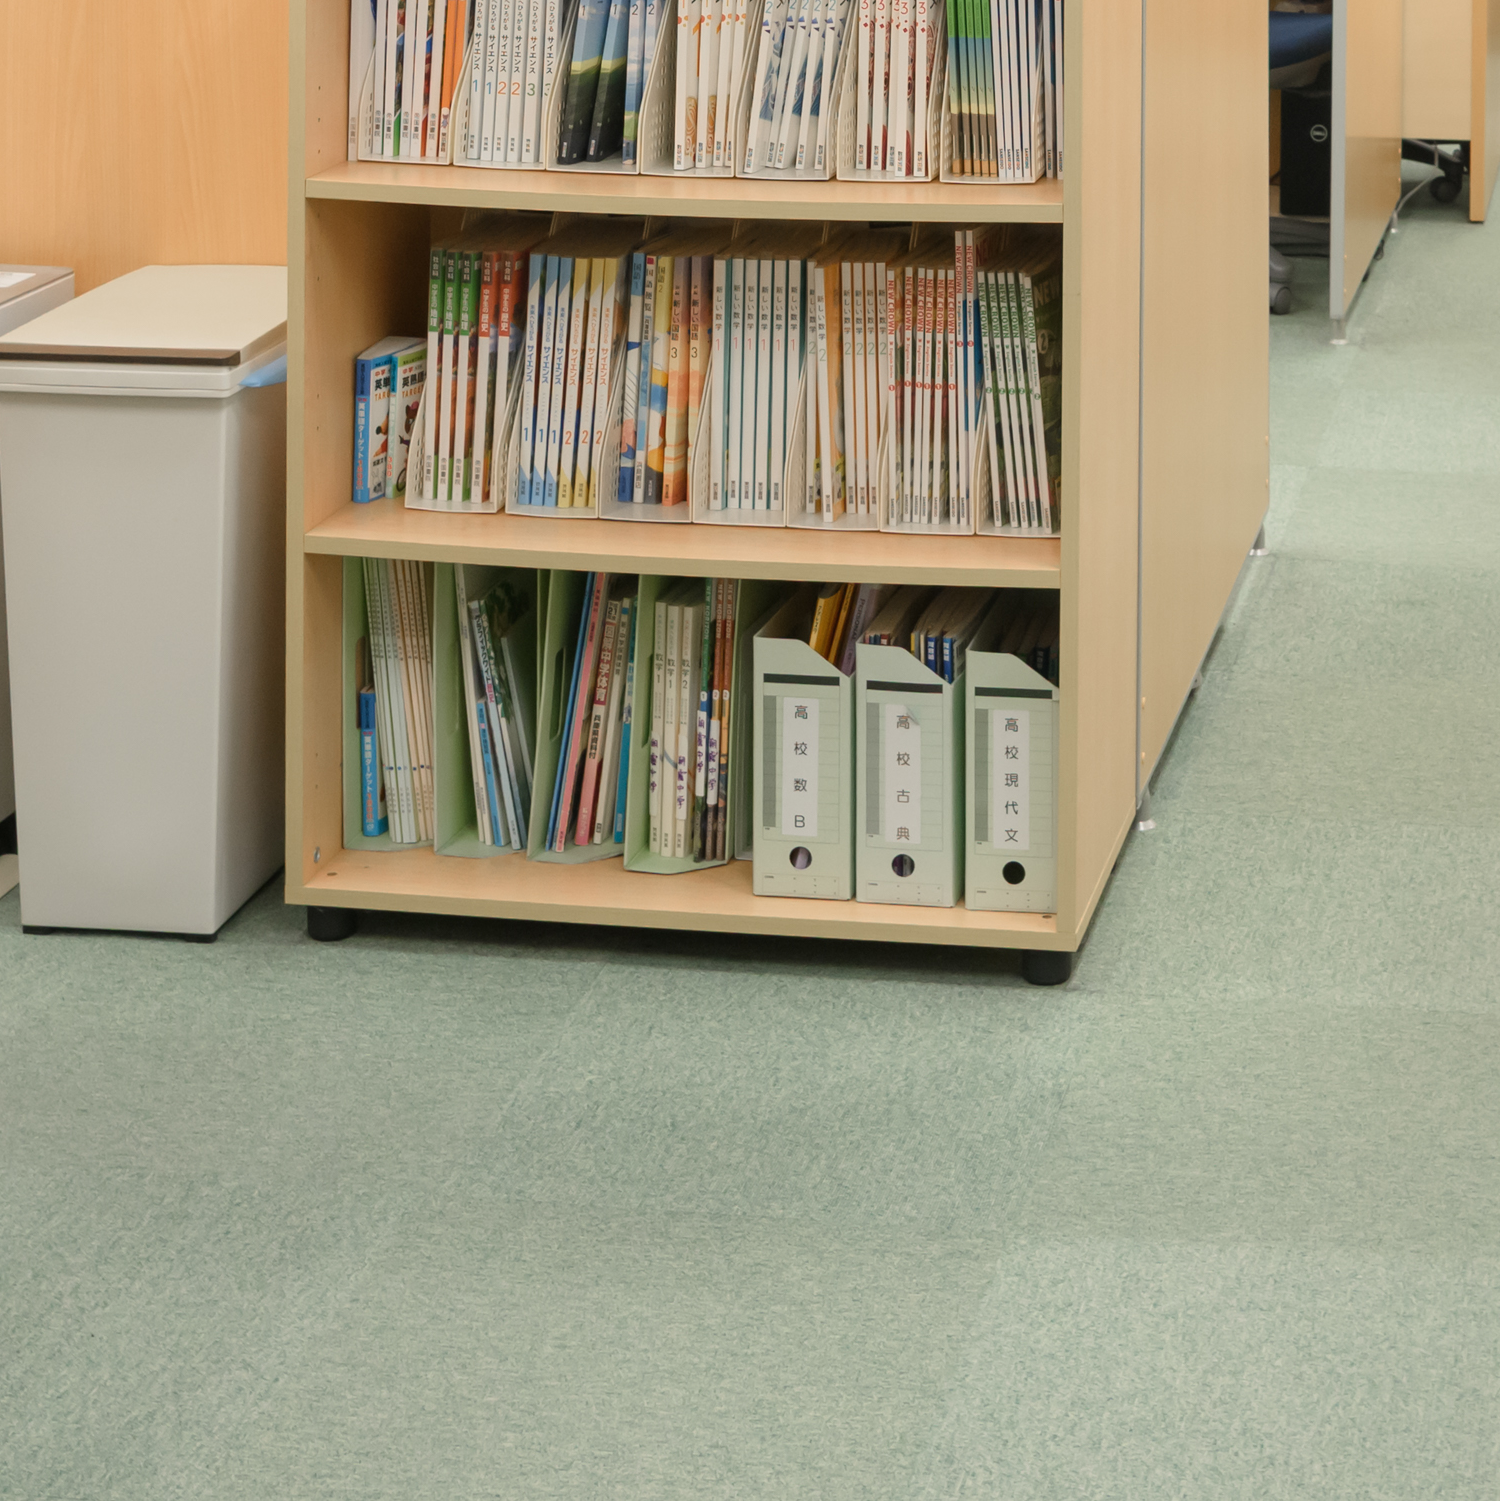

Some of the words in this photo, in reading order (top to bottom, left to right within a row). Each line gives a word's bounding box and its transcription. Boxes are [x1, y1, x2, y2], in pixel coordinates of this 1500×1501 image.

[631, 4, 638, 15] 2
[473, 32, 482, 70] サイエンス
[529, 36, 537, 74] サイエンス
[473, 79, 478, 92] 1
[527, 83, 536, 96] 3
[715, 285, 723, 331] 新しい数学
[1025, 288, 1033, 308] NEW
[817, 295, 826, 340] 新しい数学
[1027, 309, 1036, 343] CROWN
[670, 347, 678, 358] 3
[715, 338, 720, 351] 1
[819, 349, 826, 362] 2
[569, 348, 578, 385] サイエンス
[565, 431, 572, 445] 2
[655, 653, 664, 671] 数学
[793, 704, 808, 829] 高校数B
[896, 714, 911, 842] 高校古典
[1004, 717, 1020, 843] 高校現代文
